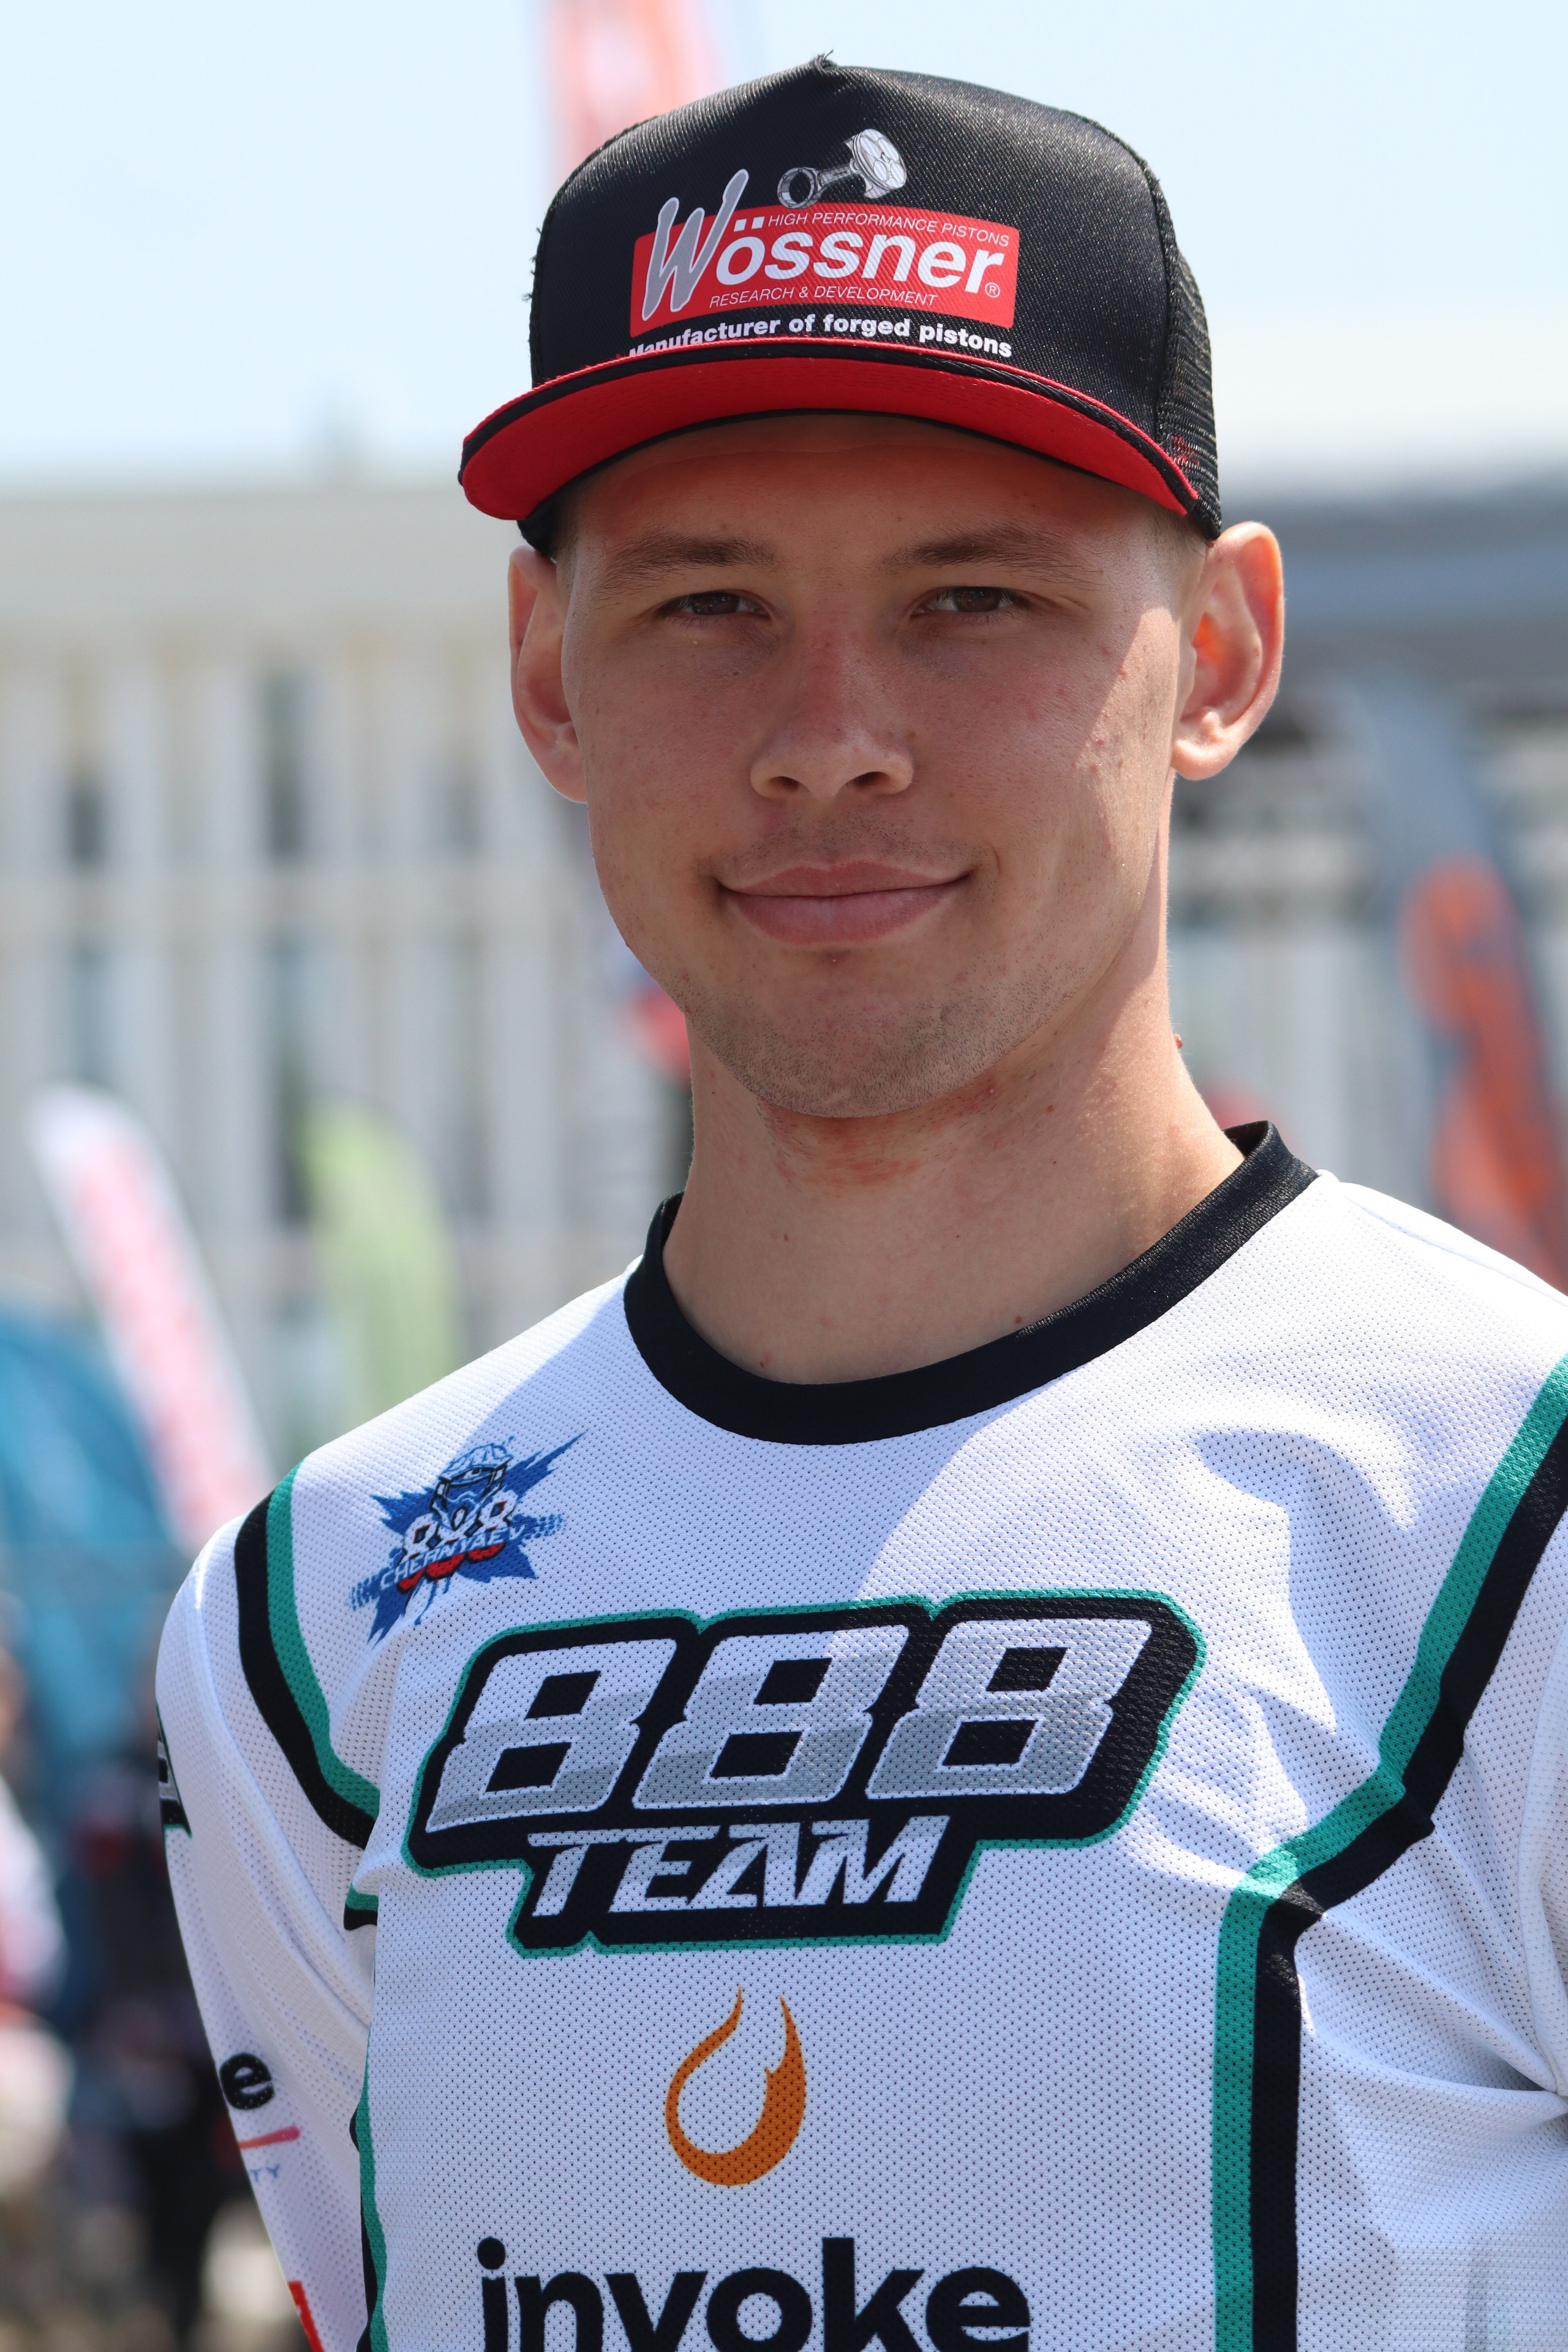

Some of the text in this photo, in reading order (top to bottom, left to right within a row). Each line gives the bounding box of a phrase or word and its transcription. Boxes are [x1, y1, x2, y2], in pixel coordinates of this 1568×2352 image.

[642, 168, 1005, 322] Wössner
[768, 213, 1010, 247] HIGH PERFORMANCE PISTONS
[709, 286, 938, 308] RESEARCH & DEVELOPMENT
[788, 314, 816, 333] of
[823, 314, 911, 337] forged
[919, 323, 1012, 358] pistons
[424, 1619, 1153, 1833] 888
[527, 1815, 951, 1918] TEAM
[477, 2237, 1031, 2352] invoke
